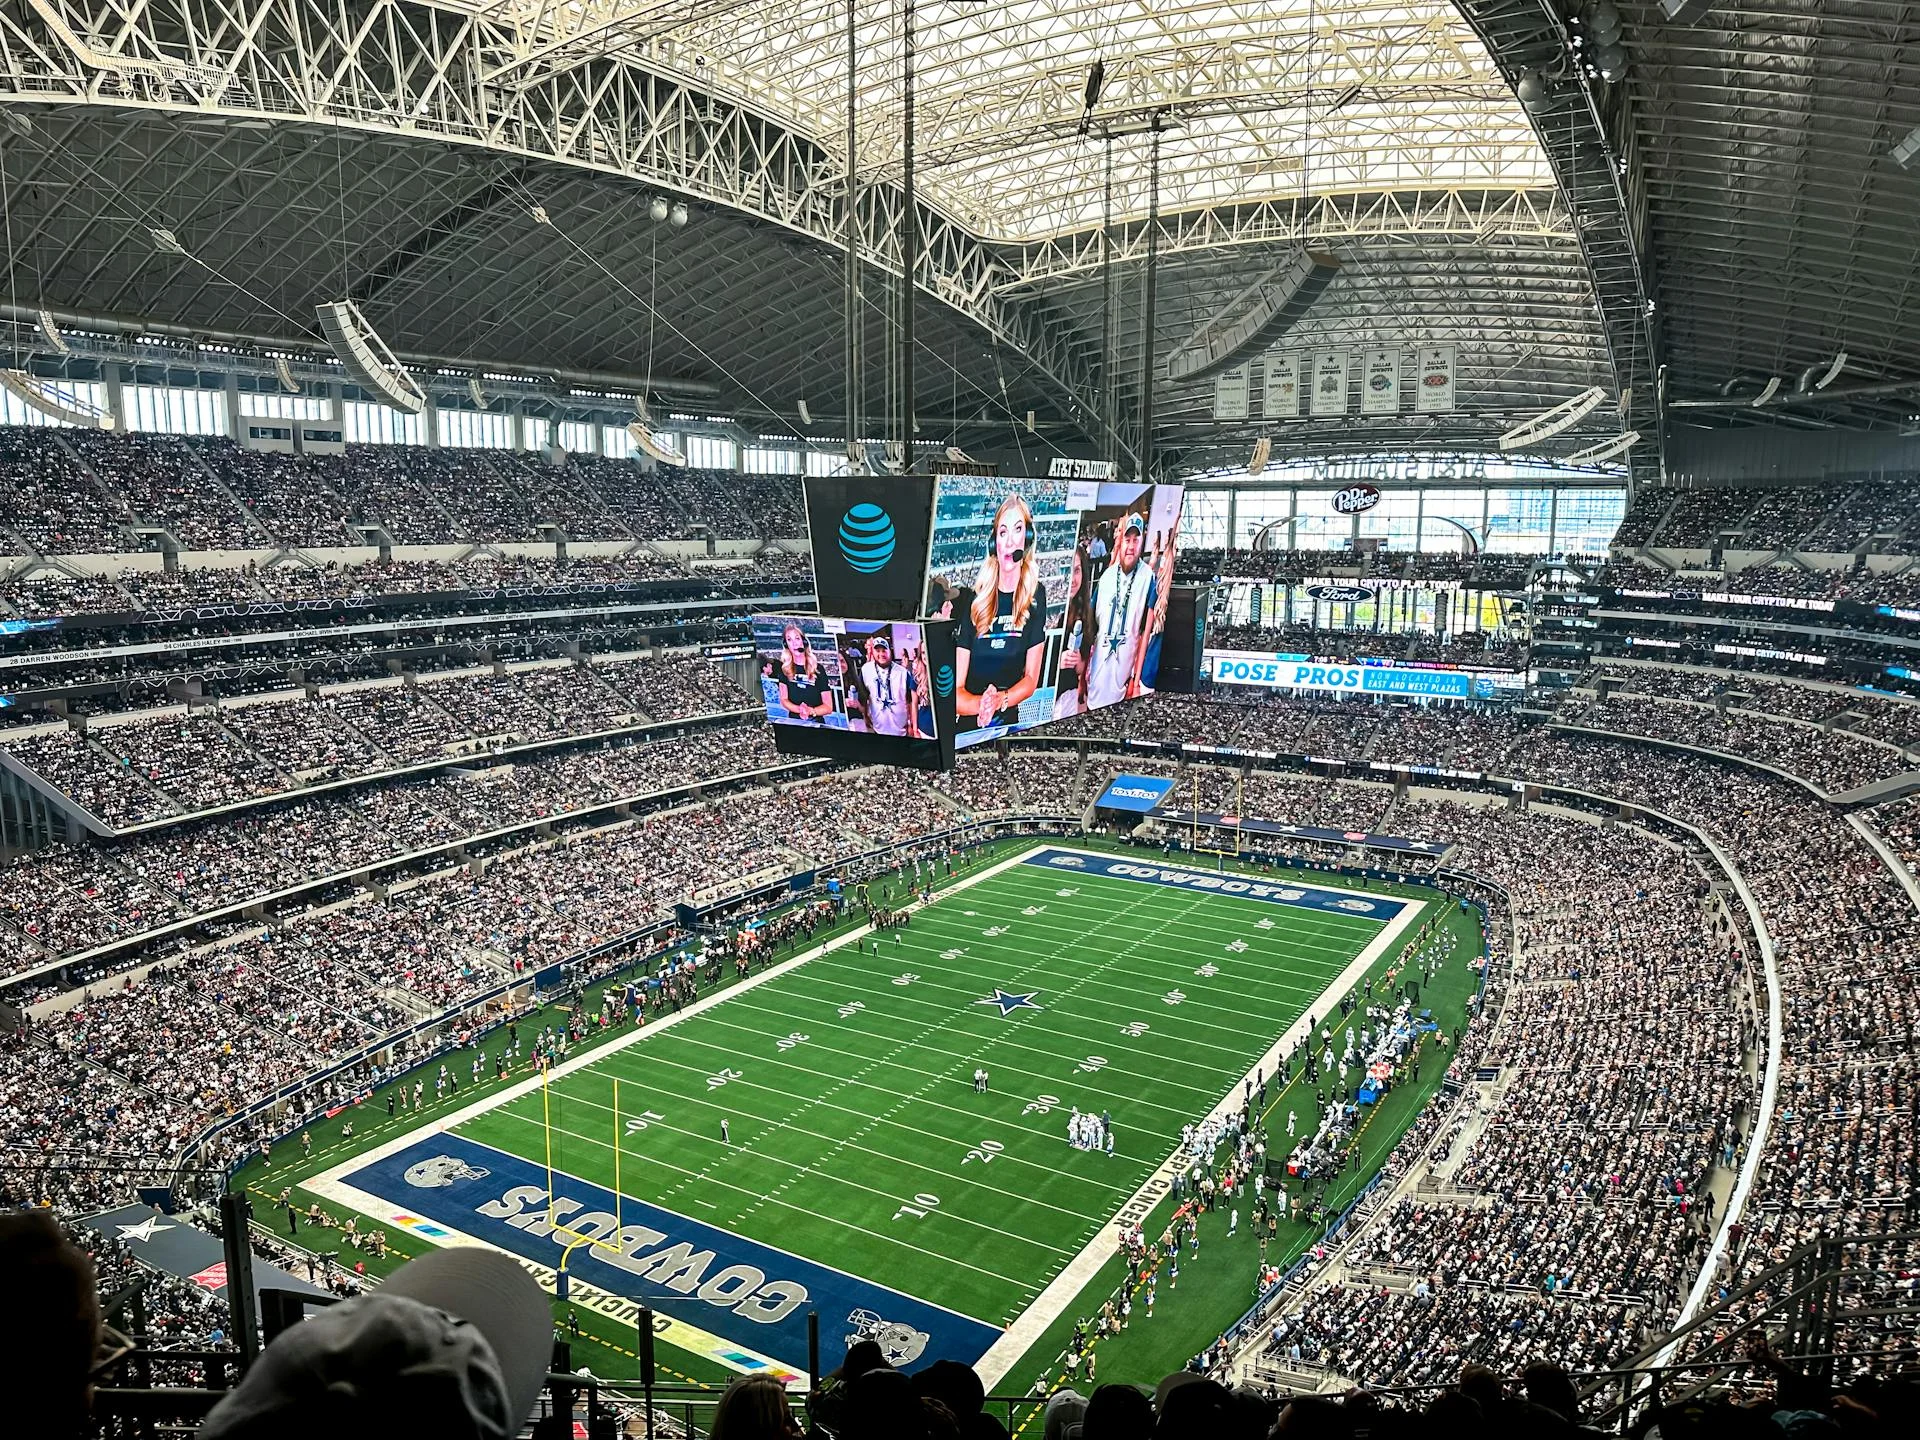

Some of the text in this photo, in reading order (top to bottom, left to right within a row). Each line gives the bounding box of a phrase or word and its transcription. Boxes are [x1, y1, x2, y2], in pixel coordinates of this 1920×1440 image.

[1049, 458, 1112, 479] AT&T STADIUM
[1333, 490, 1378, 511] Pepper
[1350, 488, 1367, 500] Dr
[1304, 577, 1462, 590] MAKE YOUR CRYPTO PLAY TODAY
[1319, 587, 1360, 600] Ford
[1702, 593, 1835, 612] MAKE YOUR CRYPTO PLAY TODAY
[20, 655, 51, 664] DARREN
[52, 652, 89, 660] WOODSON
[1714, 644, 1827, 665] MAKE YOUR CRYPTO PLAY TODAY
[1218, 661, 1359, 687] POSE PROS
[1370, 672, 1457, 683] NOW LOCATED IN
[1367, 680, 1461, 694] EAST AND WEST PLAZAS
[1216, 747, 1239, 755] CRYPTO
[1410, 766, 1438, 775] CRYPTO
[1107, 864, 1306, 900] COWBOYS
[892, 972, 921, 986] 50
[1161, 989, 1187, 1005] 40
[837, 1001, 866, 1015] 40
[1120, 1021, 1150, 1037] 50
[775, 1032, 810, 1049] 30
[1079, 1055, 1108, 1072] 40
[706, 1067, 743, 1087] 20
[1026, 1094, 1060, 1114] 30
[625, 1109, 665, 1130] 10
[966, 1140, 1005, 1164] 20
[900, 1193, 941, 1219] 10
[1113, 1179, 1170, 1229] CANCER
[475, 1185, 808, 1324] COWBOYS
[571, 1282, 672, 1333] CUCIAL
